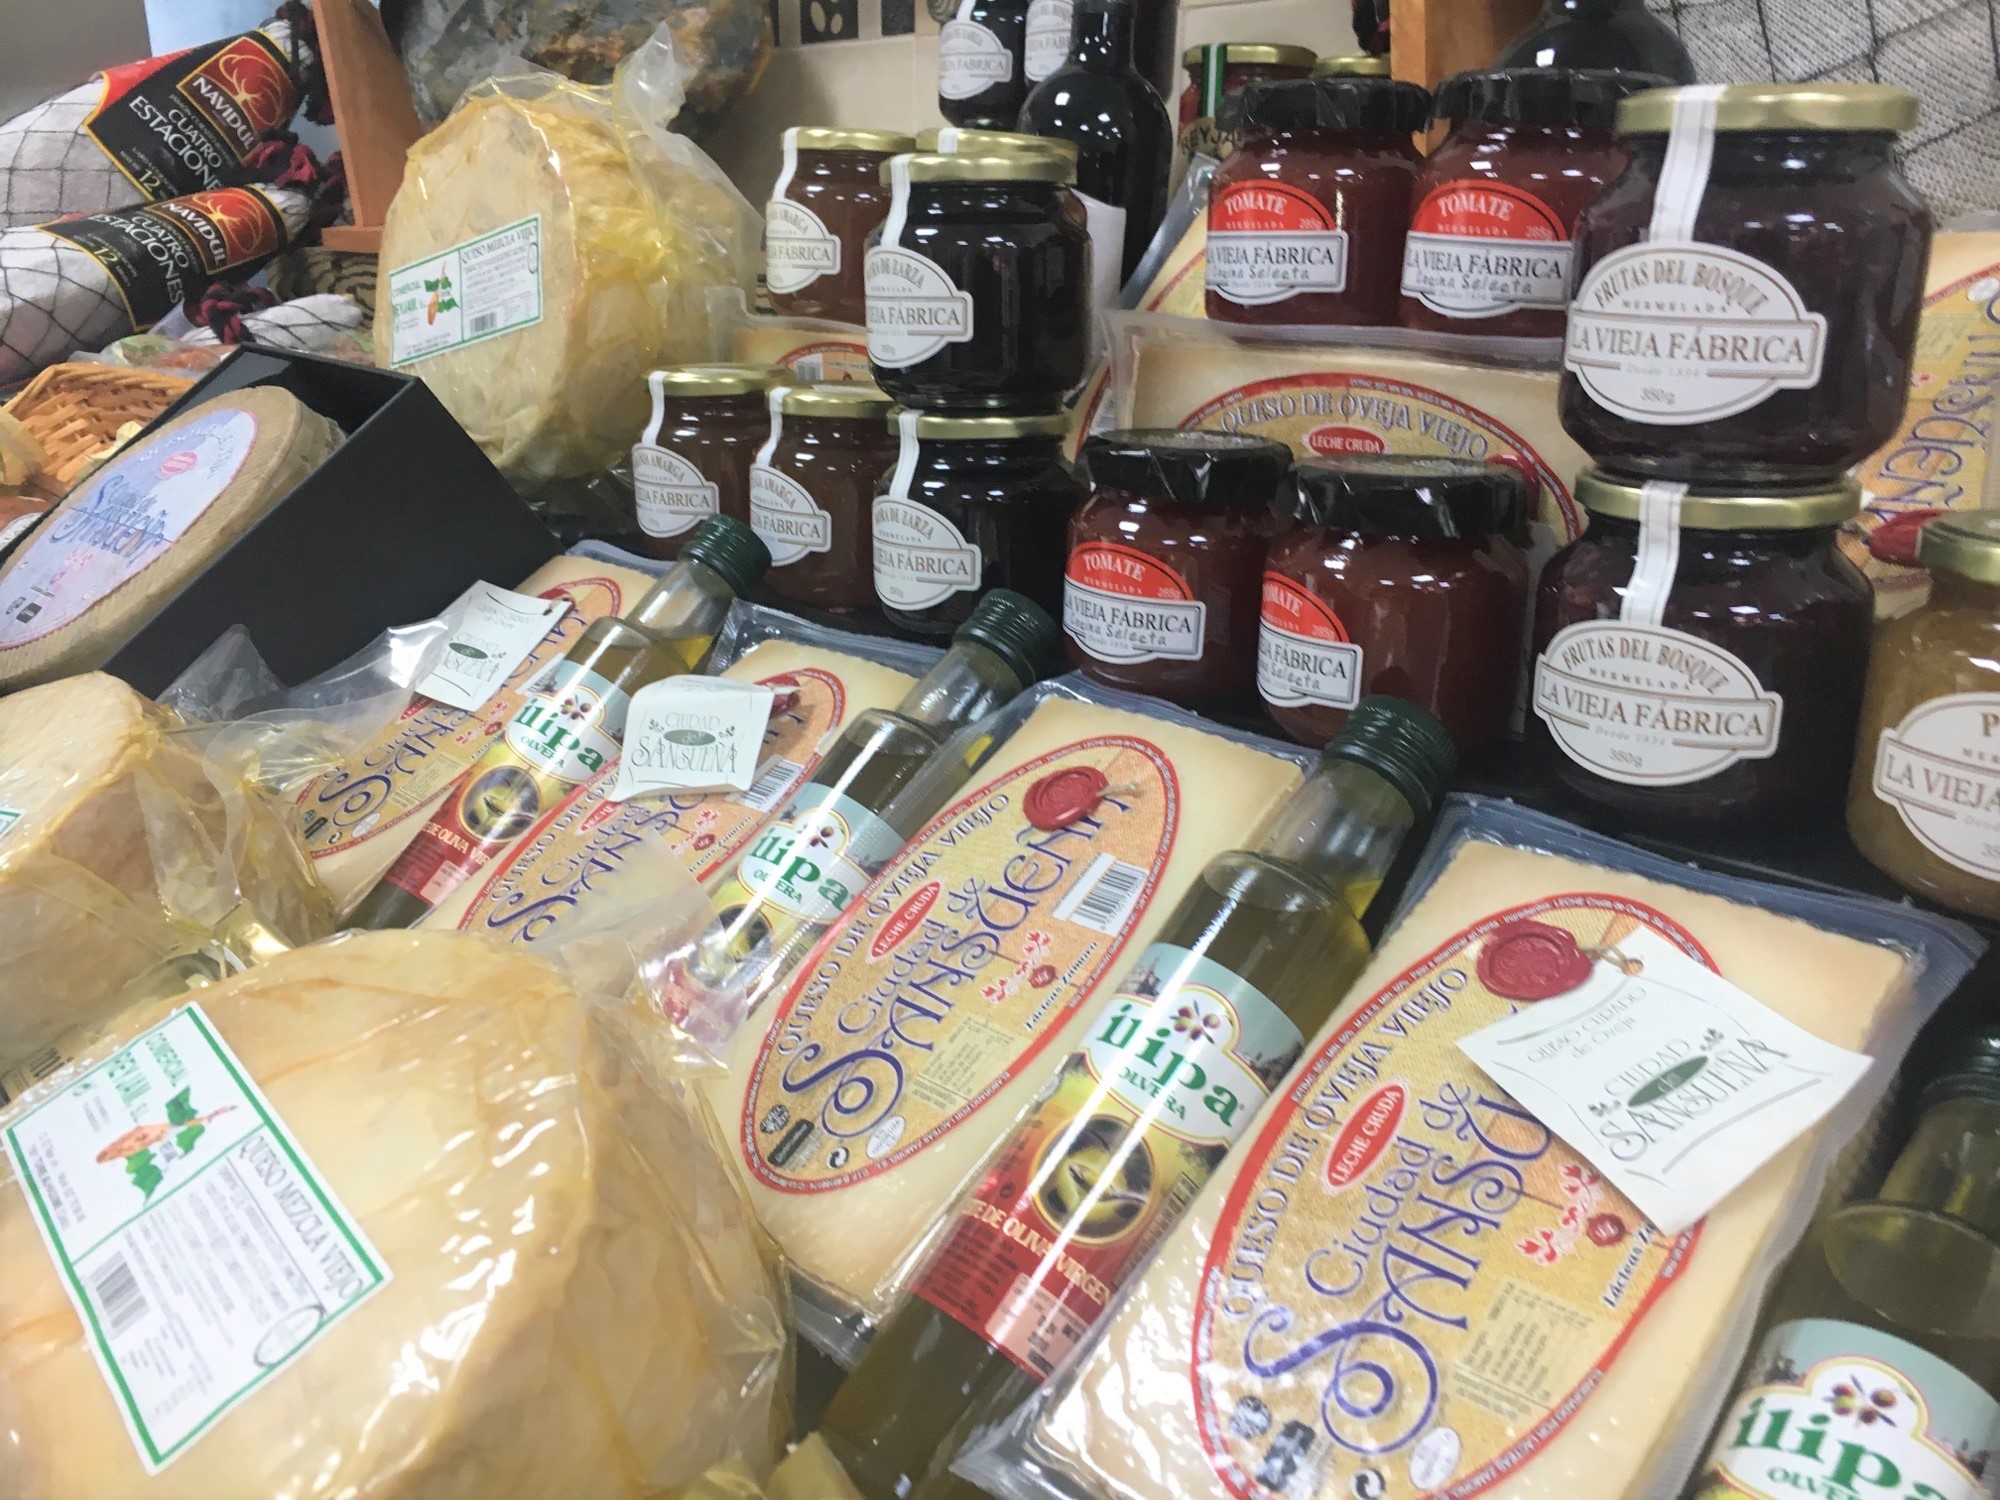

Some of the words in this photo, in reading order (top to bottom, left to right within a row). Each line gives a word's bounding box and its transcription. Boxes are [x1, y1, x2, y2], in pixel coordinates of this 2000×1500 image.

[169, 109, 221, 168] CUATRO
[192, 77, 254, 150] NAVIDUL
[139, 169, 160, 192] 12
[1224, 191, 1288, 216] TOMATE
[1437, 192, 1515, 222] TOMATE
[132, 215, 188, 268] CUATRO
[162, 203, 226, 265] NAVIDUL
[1421, 249, 1462, 273] VIEJA
[1593, 260, 1650, 309] FRUTAS
[1652, 258, 1688, 285] DEL
[1621, 300, 1729, 314] MERMELADA
[1570, 321, 1592, 352] LA
[1591, 324, 1661, 360] VIEJA
[1221, 395, 1297, 434] QUESO
[1300, 391, 1334, 416] DE
[1337, 392, 1412, 430] OVEJA
[1418, 409, 1490, 460] VIEJO
[1311, 434, 1344, 451] LECHE
[1345, 436, 1382, 454] CRUDA
[1082, 552, 1147, 583] TOMATE
[1083, 575, 1144, 596] MERMELADA
[1074, 596, 1107, 623] VIEJA
[1106, 623, 1168, 647] Selecta
[1561, 635, 1617, 672] FRUTAS
[1618, 636, 1655, 663] DEL
[1657, 643, 1731, 695] BOSQUE
[1588, 666, 1691, 692] MERMELADA
[666, 711, 722, 729] CIUDAD
[1539, 674, 1561, 707] LA
[1561, 684, 1629, 726] VIEJA
[1886, 753, 1916, 790] LA
[490, 831, 556, 903] QUESO
[553, 803, 585, 831] DE
[777, 961, 843, 1057] QUESO
[841, 921, 875, 968] DE
[866, 845, 946, 920] OVEJA
[938, 793, 1012, 852] VIEJO
[872, 913, 909, 959] LECHE
[905, 884, 942, 922] CRUDA
[837, 918, 950, 1036] Ciudad
[946, 876, 998, 918] de
[1392, 965, 1471, 1043] VIEJO
[1592, 1014, 1638, 1052] Oveja
[1304, 1036, 1394, 1128] OVEJA
[1604, 1038, 1692, 1100] CIUDAD
[1286, 1133, 1325, 1188] DE
[1330, 1125, 1375, 1187] LECHE
[1362, 1086, 1405, 1134] CRUDA
[240, 1135, 288, 1188] QUESO
[275, 1180, 324, 1256] MEZCLA
[317, 1241, 365, 1300] VIEJO
[1304, 1134, 1436, 1298] Ciudad
[1222, 1187, 1290, 1323] QUESO
[1600, 1235, 1647, 1310] Lácteas
